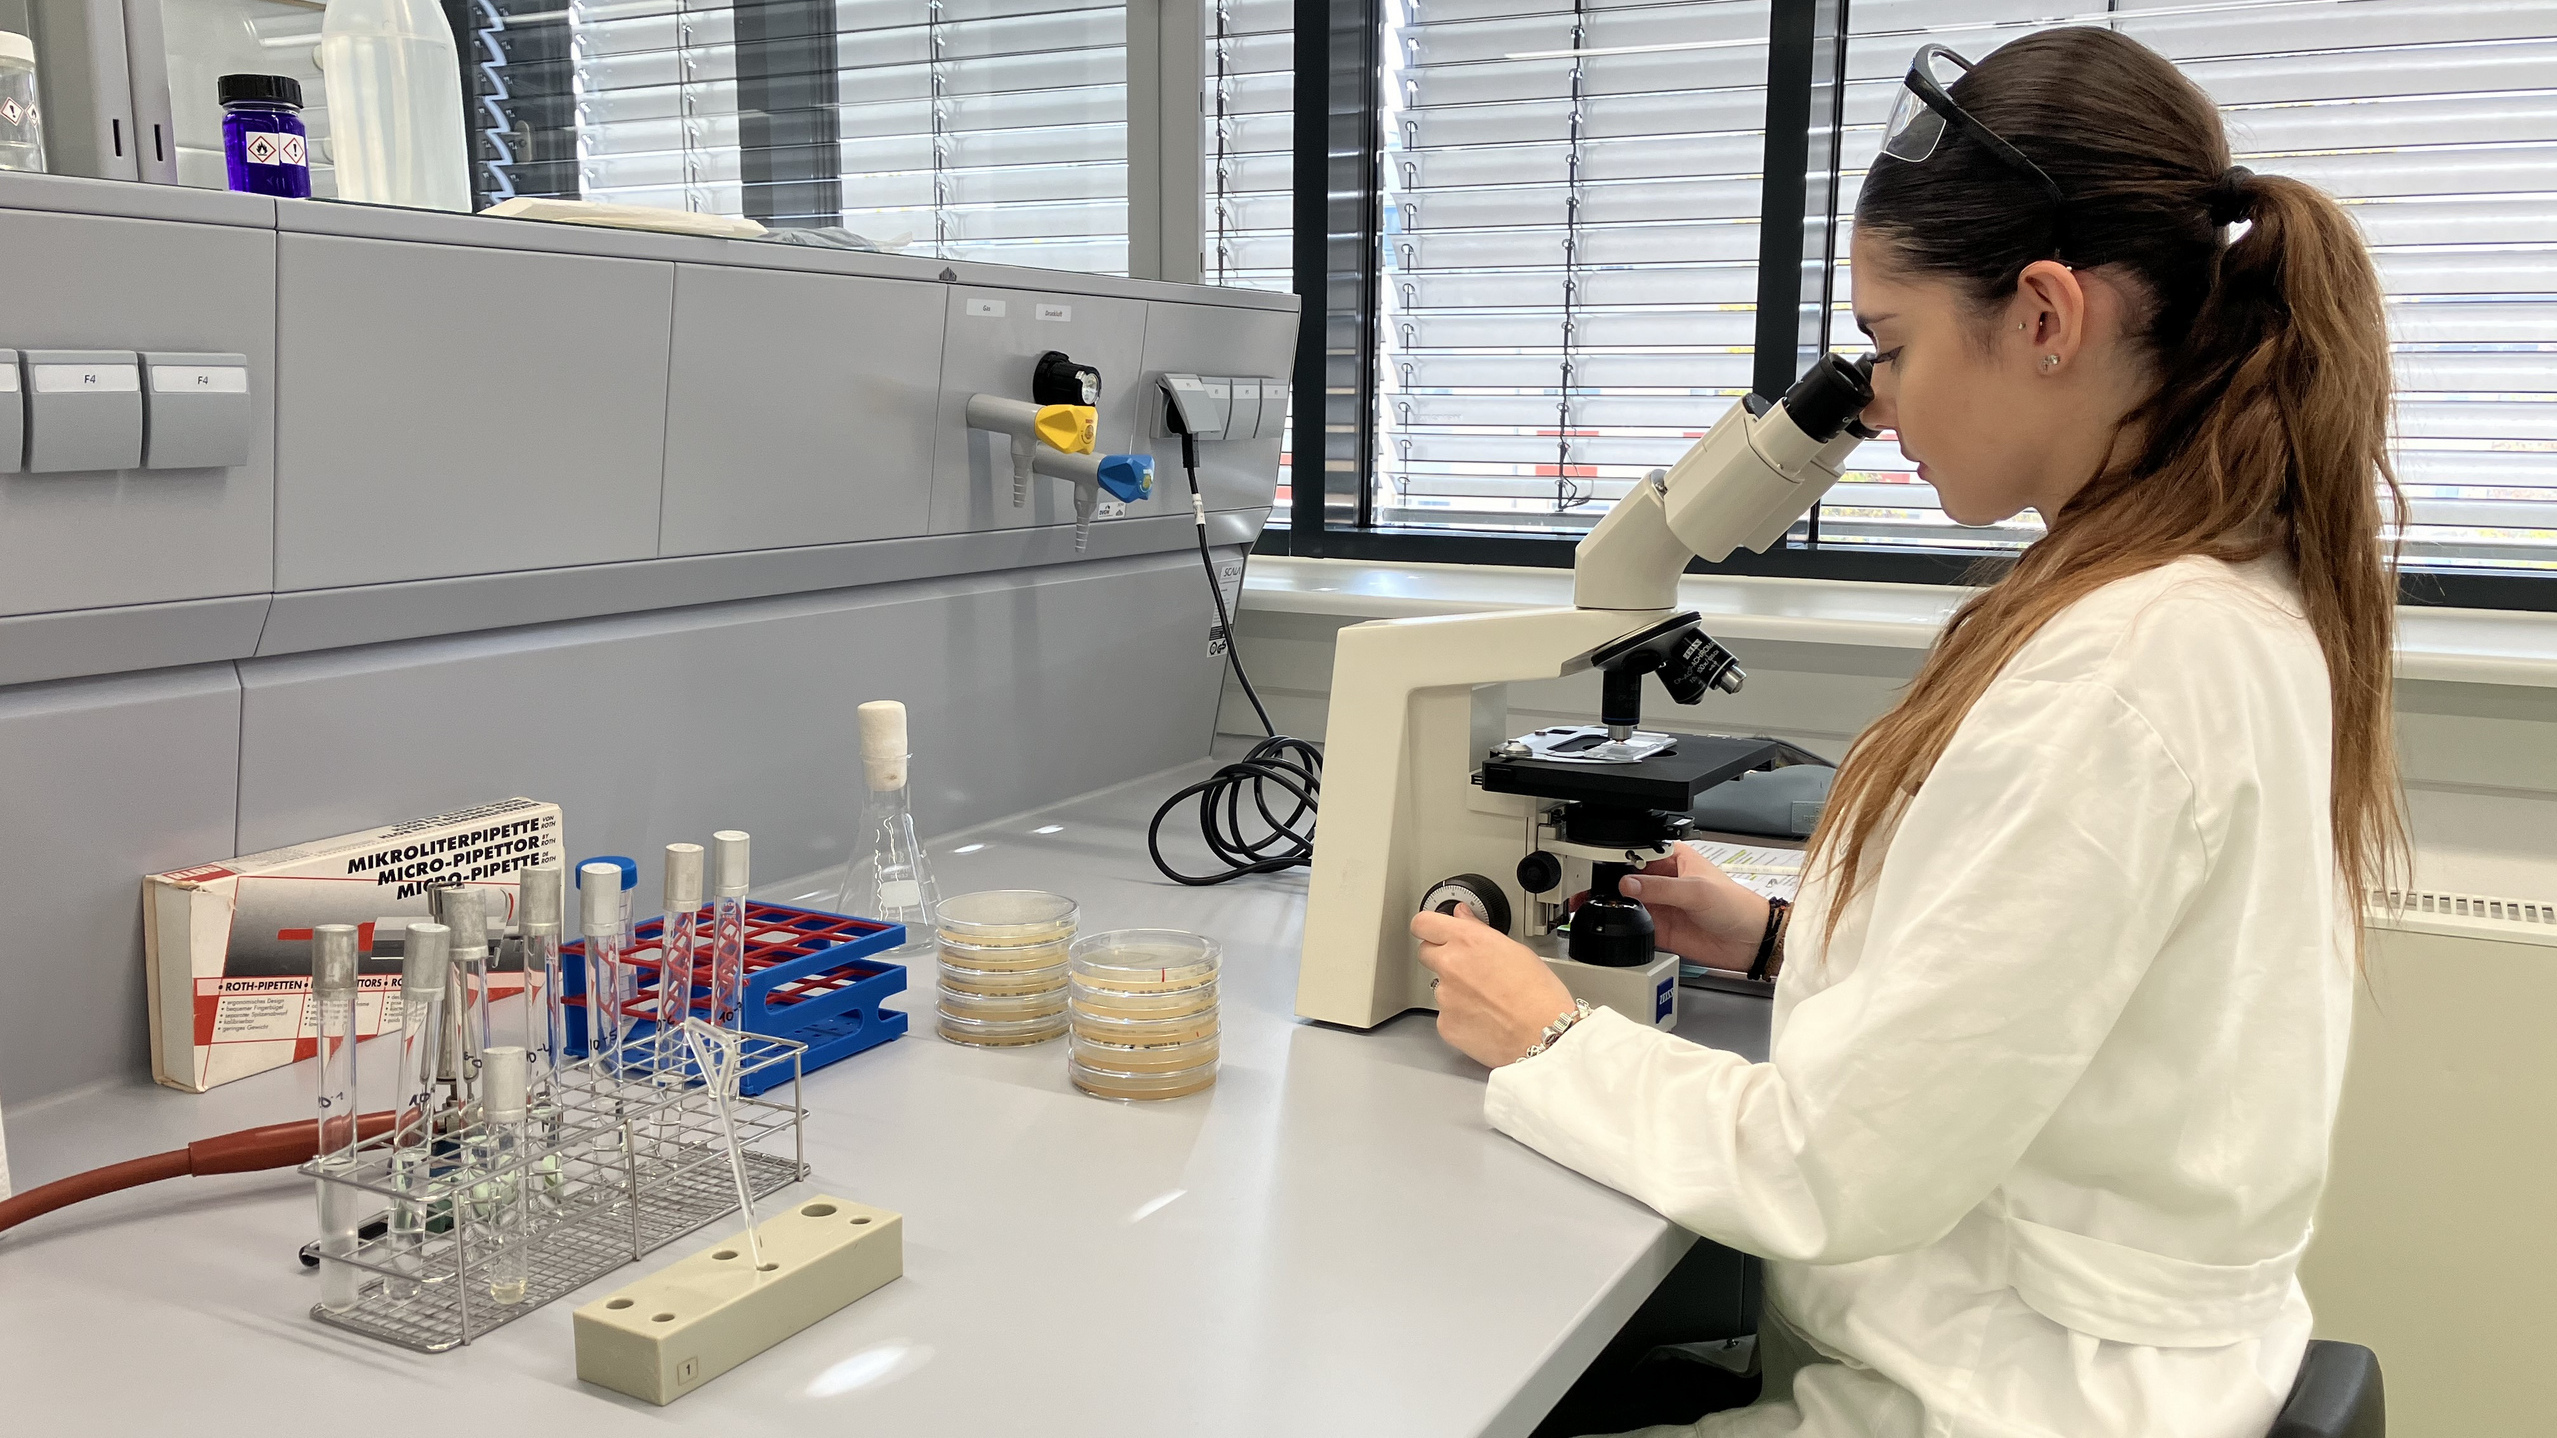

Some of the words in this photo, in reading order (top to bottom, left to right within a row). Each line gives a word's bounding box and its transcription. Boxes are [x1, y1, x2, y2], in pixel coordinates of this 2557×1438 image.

[84, 374, 96, 384] F4
[197, 376, 209, 385] F4
[541, 821, 556, 829] ROTH
[347, 817, 540, 874] MIKROLITERPIPETTE
[541, 838, 556, 846] ROTH
[377, 835, 541, 886] MICRO-PIPETTOR
[541, 856, 556, 864] ROTH
[225, 980, 303, 992] ROTH-PIPETTEN
[1660, 987, 1674, 1005] ZEISS
[686, 1363, 691, 1376] 1
